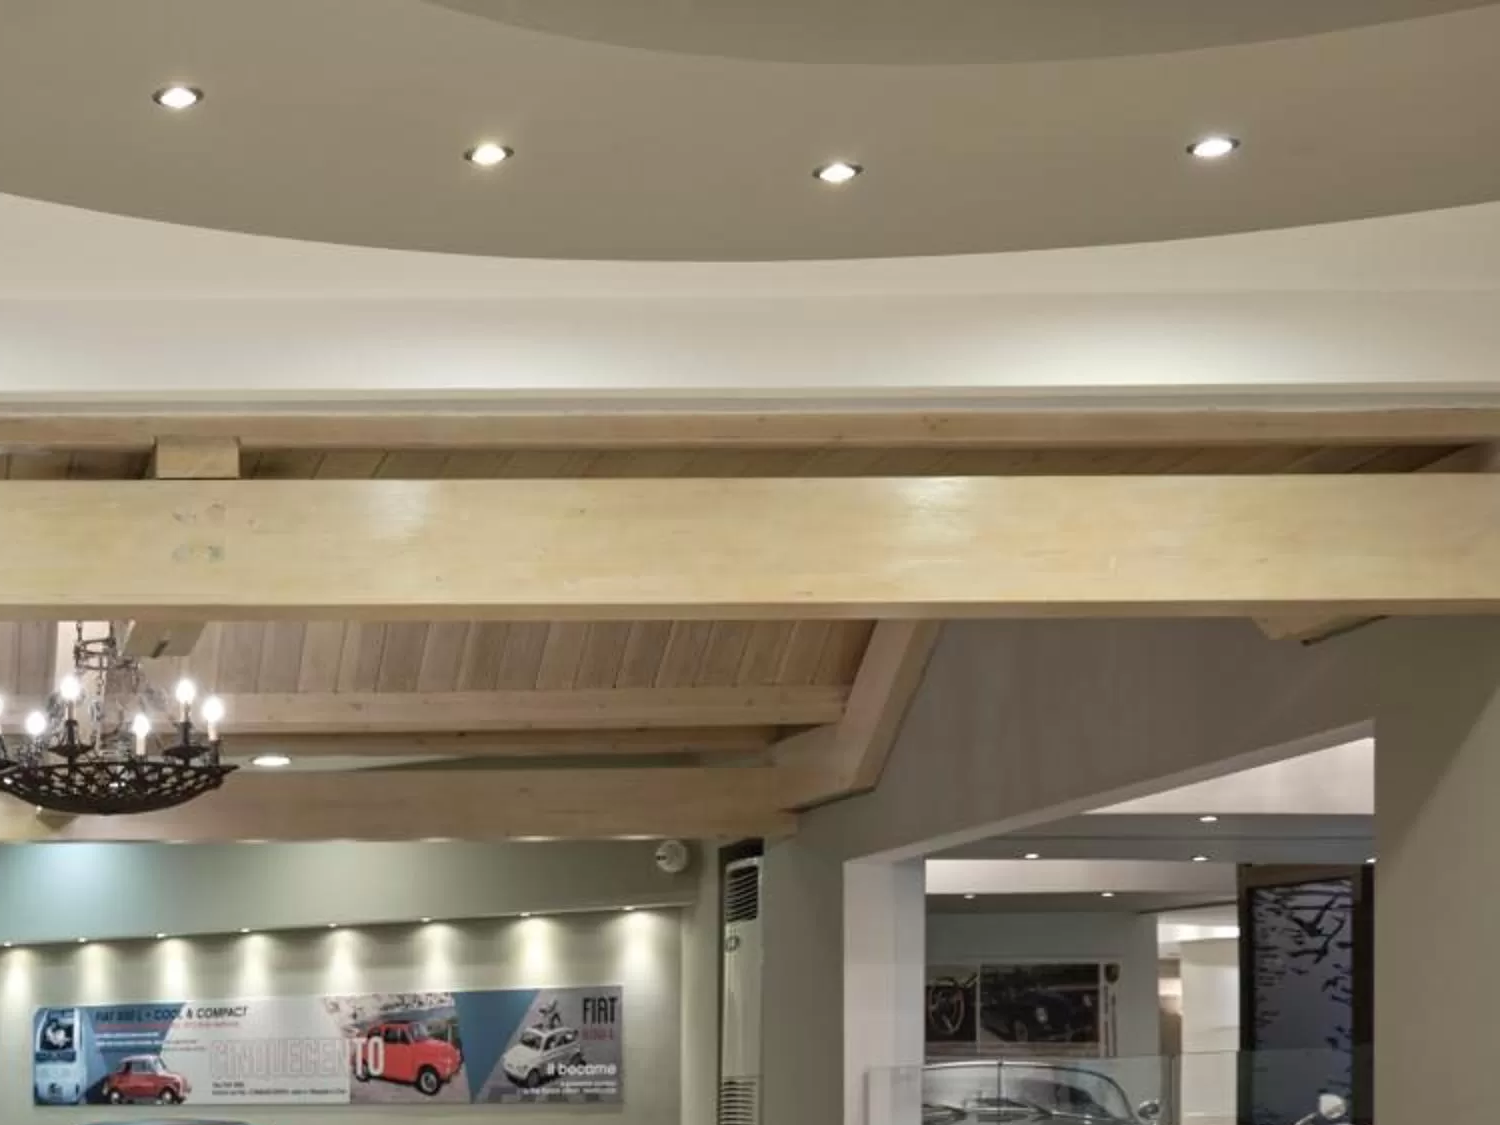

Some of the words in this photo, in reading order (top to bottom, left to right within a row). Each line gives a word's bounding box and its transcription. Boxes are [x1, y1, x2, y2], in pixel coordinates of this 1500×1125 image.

[197, 1006, 248, 1019] COMPACT
[584, 997, 617, 1024] FIAT
[211, 1036, 385, 1080] CINQUECENTO
[559, 1062, 617, 1075] became
